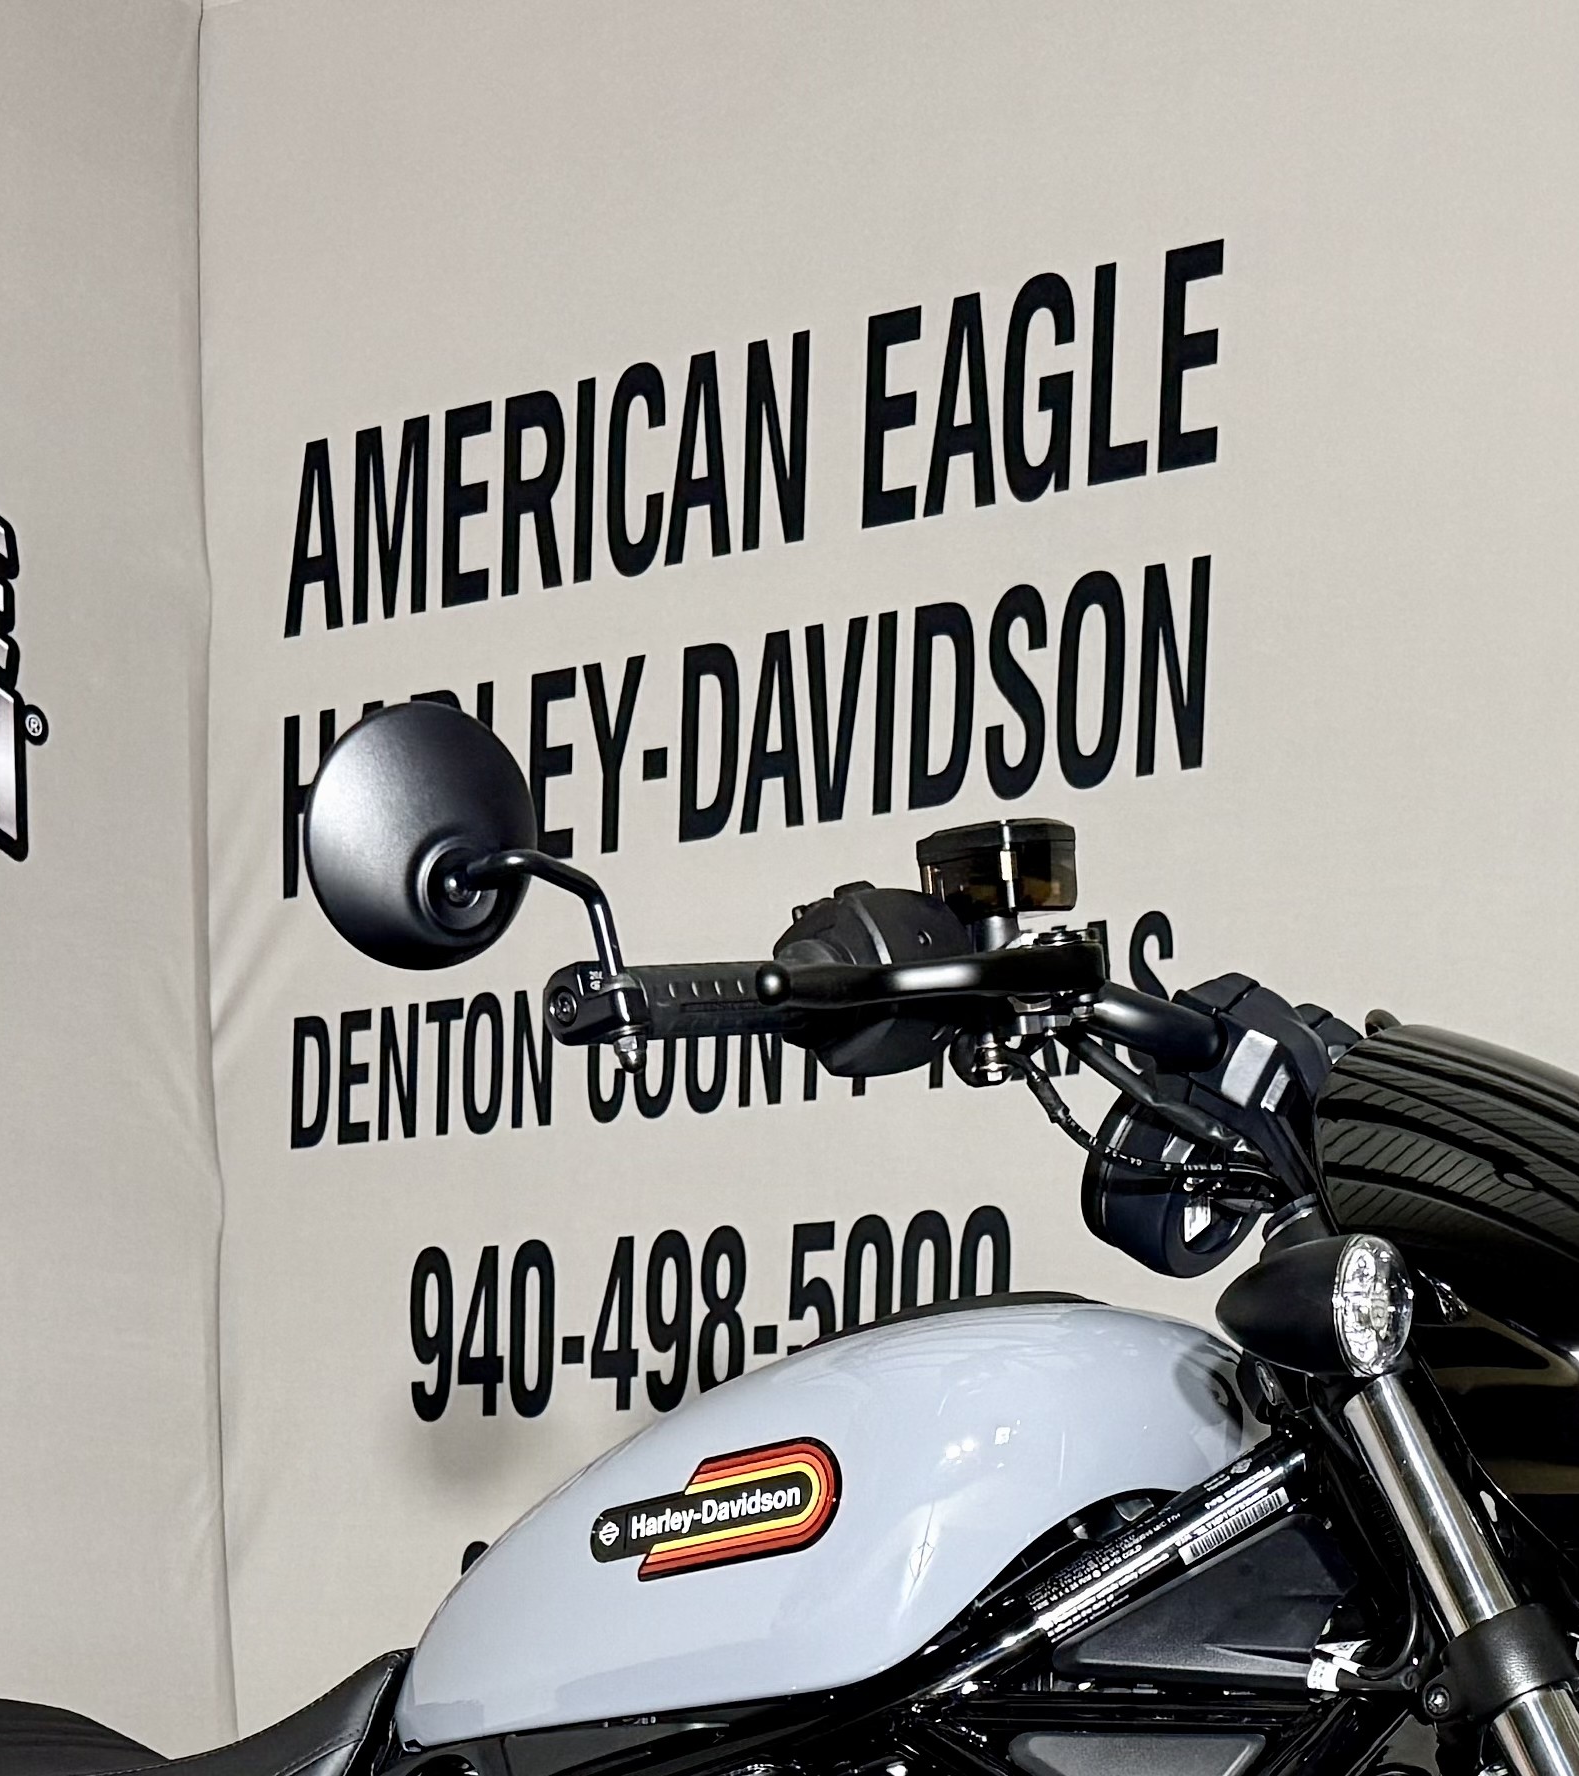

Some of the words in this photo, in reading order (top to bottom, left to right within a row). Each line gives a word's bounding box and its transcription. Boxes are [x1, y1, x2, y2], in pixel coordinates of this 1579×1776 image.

[283, 329, 811, 639] AMERICAN
[861, 238, 1225, 529] EAGLE
[283, 555, 1212, 899] HEY-DAVIDSON
[289, 989, 553, 1150] DENTON
[630, 1486, 801, 1540] Harley-Davidson
